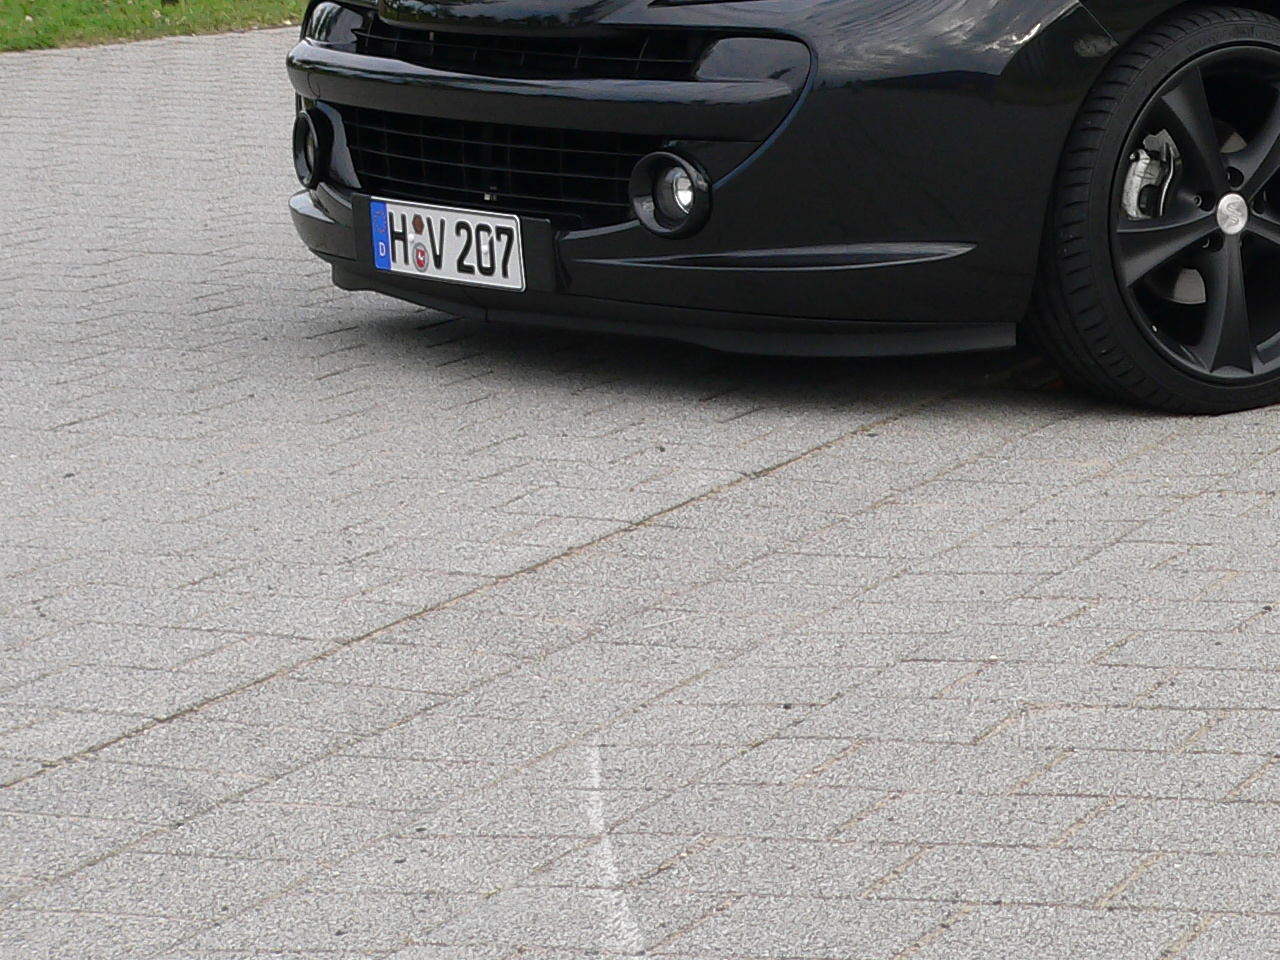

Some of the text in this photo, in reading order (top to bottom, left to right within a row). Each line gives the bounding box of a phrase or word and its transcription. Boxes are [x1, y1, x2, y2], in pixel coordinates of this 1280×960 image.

[377, 241, 386, 257] D
[388, 211, 515, 279] H V 207
